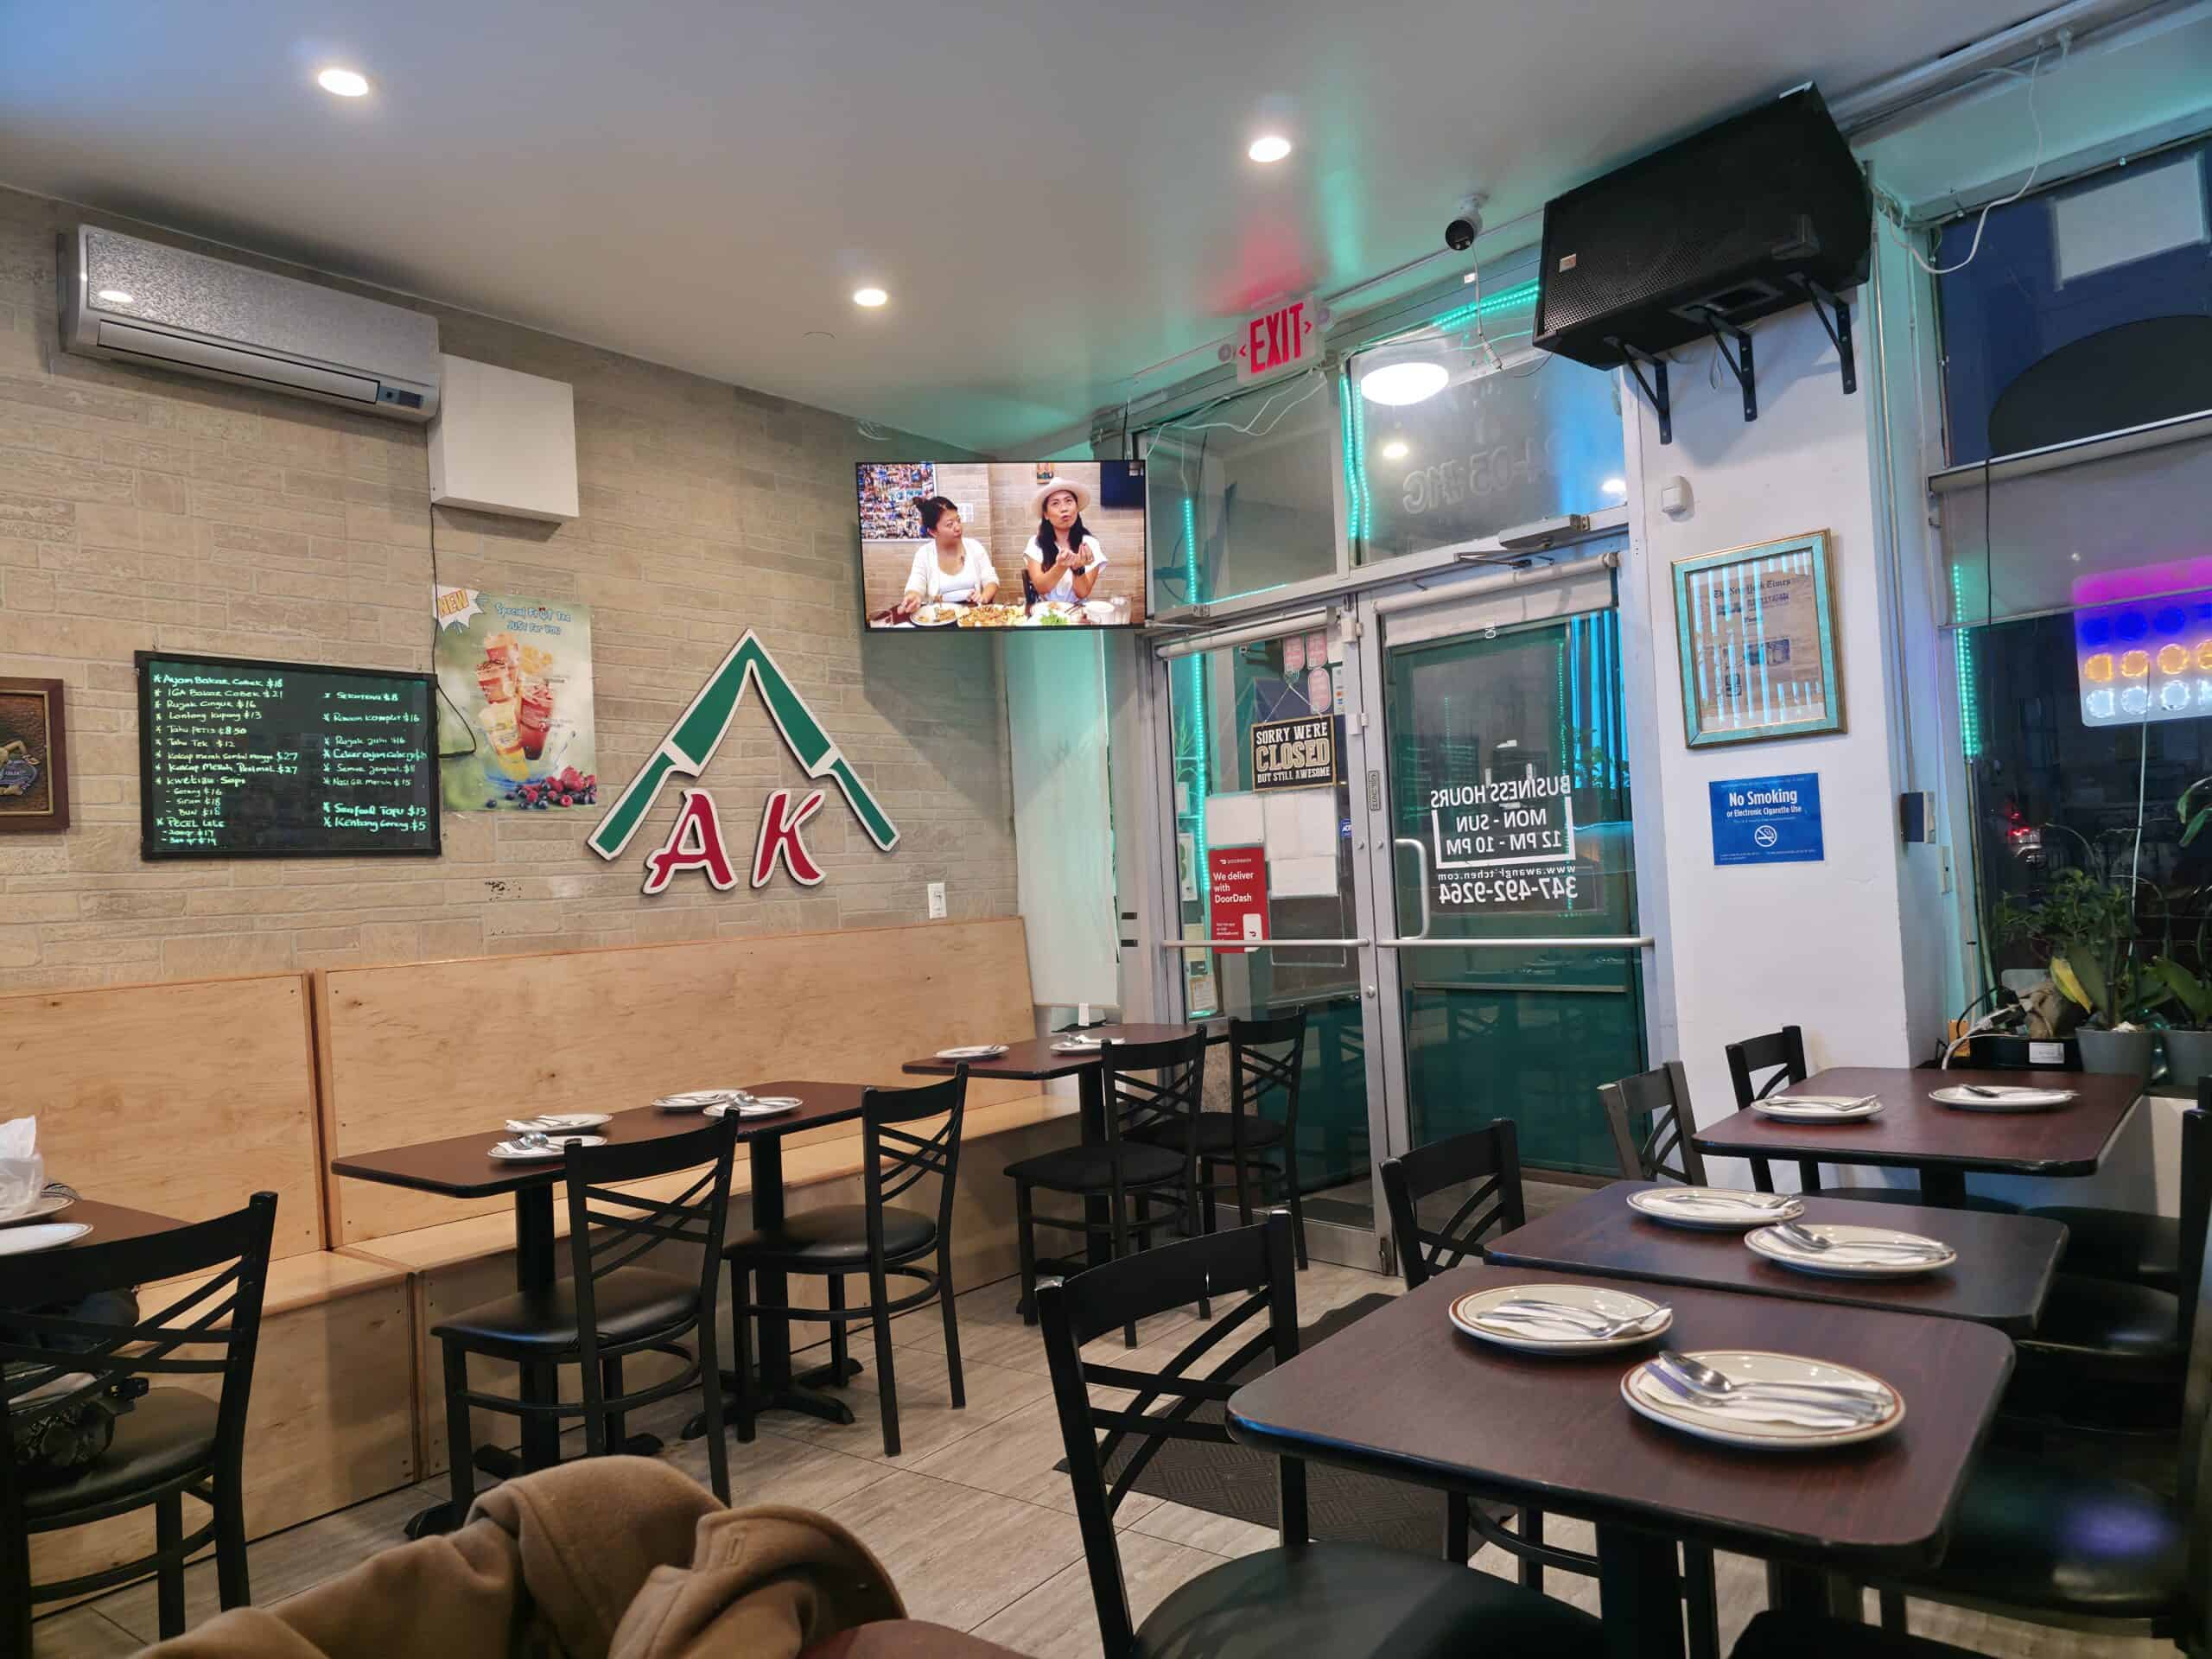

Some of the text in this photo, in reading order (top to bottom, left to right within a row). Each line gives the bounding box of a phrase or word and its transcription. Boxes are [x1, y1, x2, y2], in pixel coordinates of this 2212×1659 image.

[1250, 302, 1303, 373] EXIT
[437, 588, 469, 619] NEW
[1256, 722, 1328, 745] SORRY WERE
[276, 752, 298, 761] $27
[1256, 738, 1330, 772] CLOSED
[276, 764, 297, 774] $27
[1257, 767, 1331, 783] BUT STILL AWESOME
[1729, 788, 1797, 806] No Smoking
[407, 804, 427, 817] $13
[1734, 808, 1763, 817] Electronic
[1763, 806, 1789, 816] Cigarette
[1790, 804, 1802, 813] Use
[410, 819, 426, 831] $5
[1213, 871, 1254, 880] We deliver
[1214, 883, 1230, 892] with
[1215, 893, 1252, 903] DoorDash
